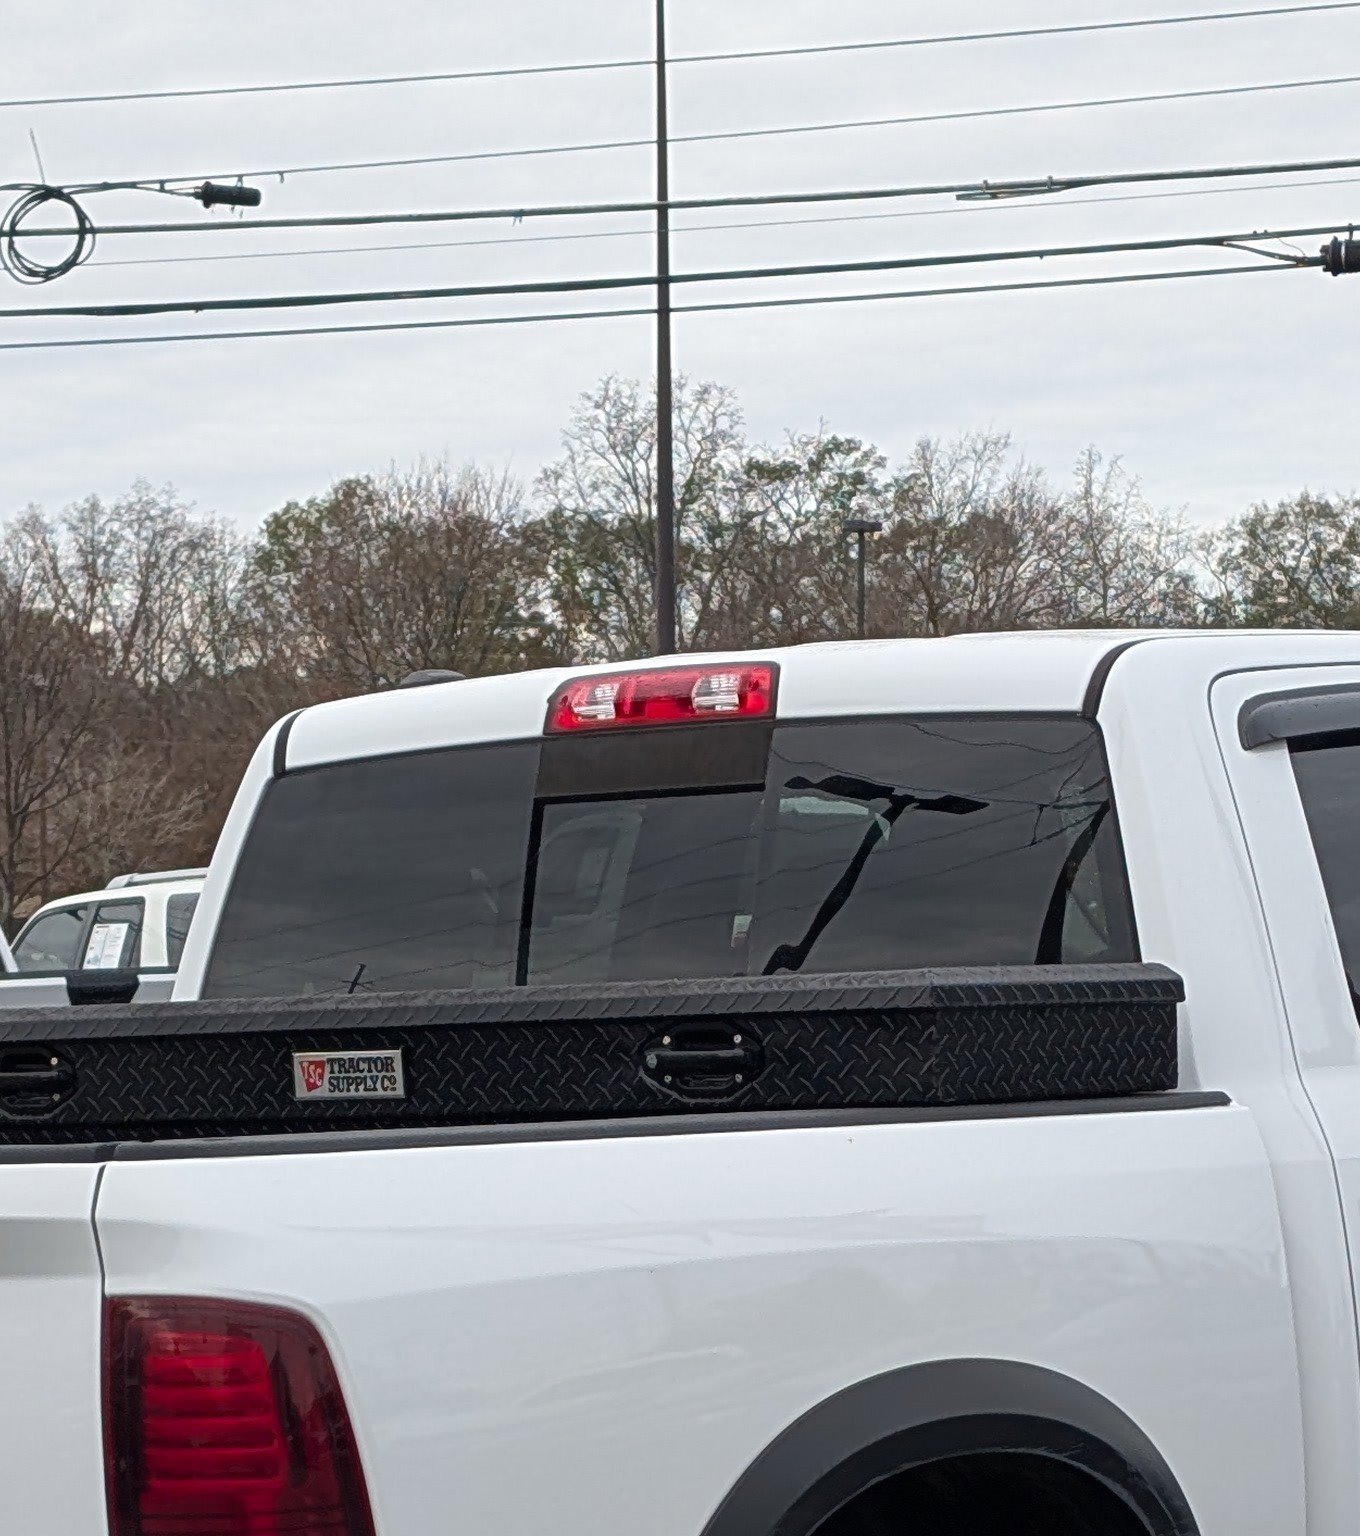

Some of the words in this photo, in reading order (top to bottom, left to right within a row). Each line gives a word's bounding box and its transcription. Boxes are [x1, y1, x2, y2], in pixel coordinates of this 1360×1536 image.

[301, 1061, 323, 1086] TSC
[326, 1057, 396, 1074] TRACTOR
[328, 1075, 379, 1092] SUPPLY
